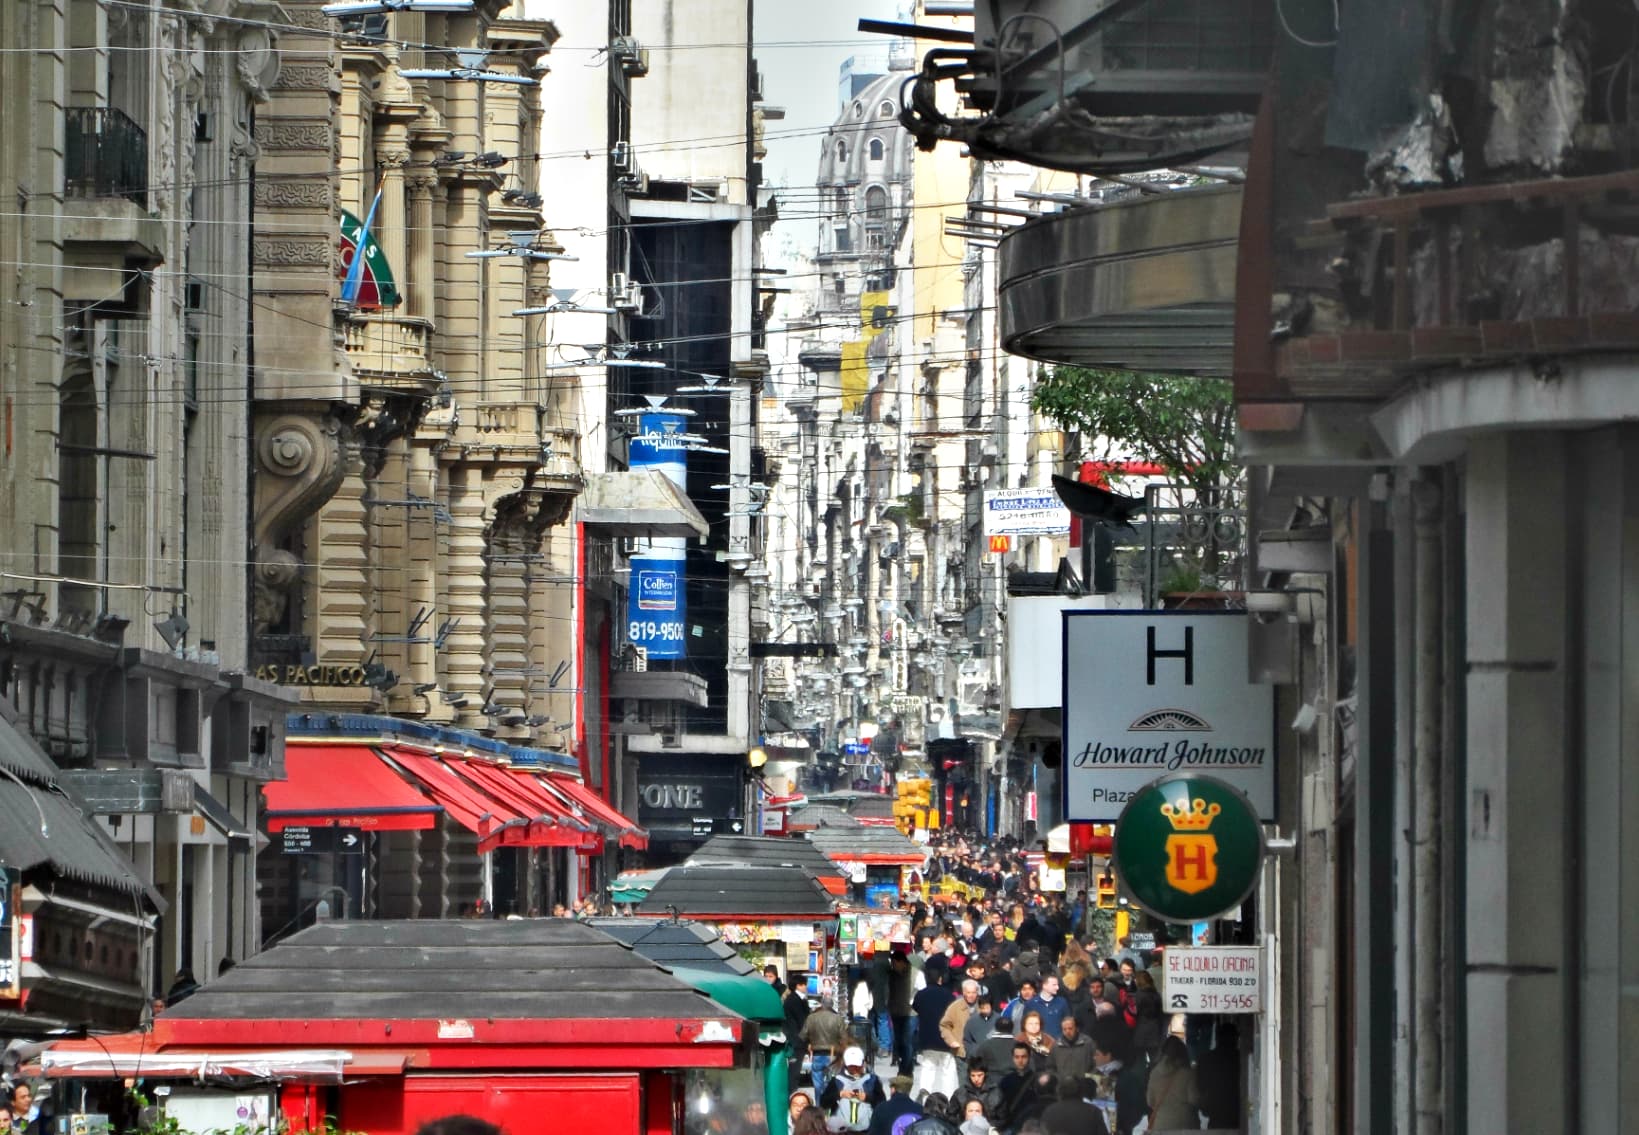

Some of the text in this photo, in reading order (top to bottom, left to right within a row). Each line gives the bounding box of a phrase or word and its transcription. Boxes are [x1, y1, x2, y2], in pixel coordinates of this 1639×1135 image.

[1147, 626, 1193, 685] H
[1073, 740, 1265, 771] Howard Johnson
[1093, 788, 1137, 803] Plaza
[1174, 844, 1208, 881] H
[1169, 956, 1180, 971] SE
[1184, 957, 1218, 972] ALQUILA
[1200, 977, 1227, 986] FLORIDA
